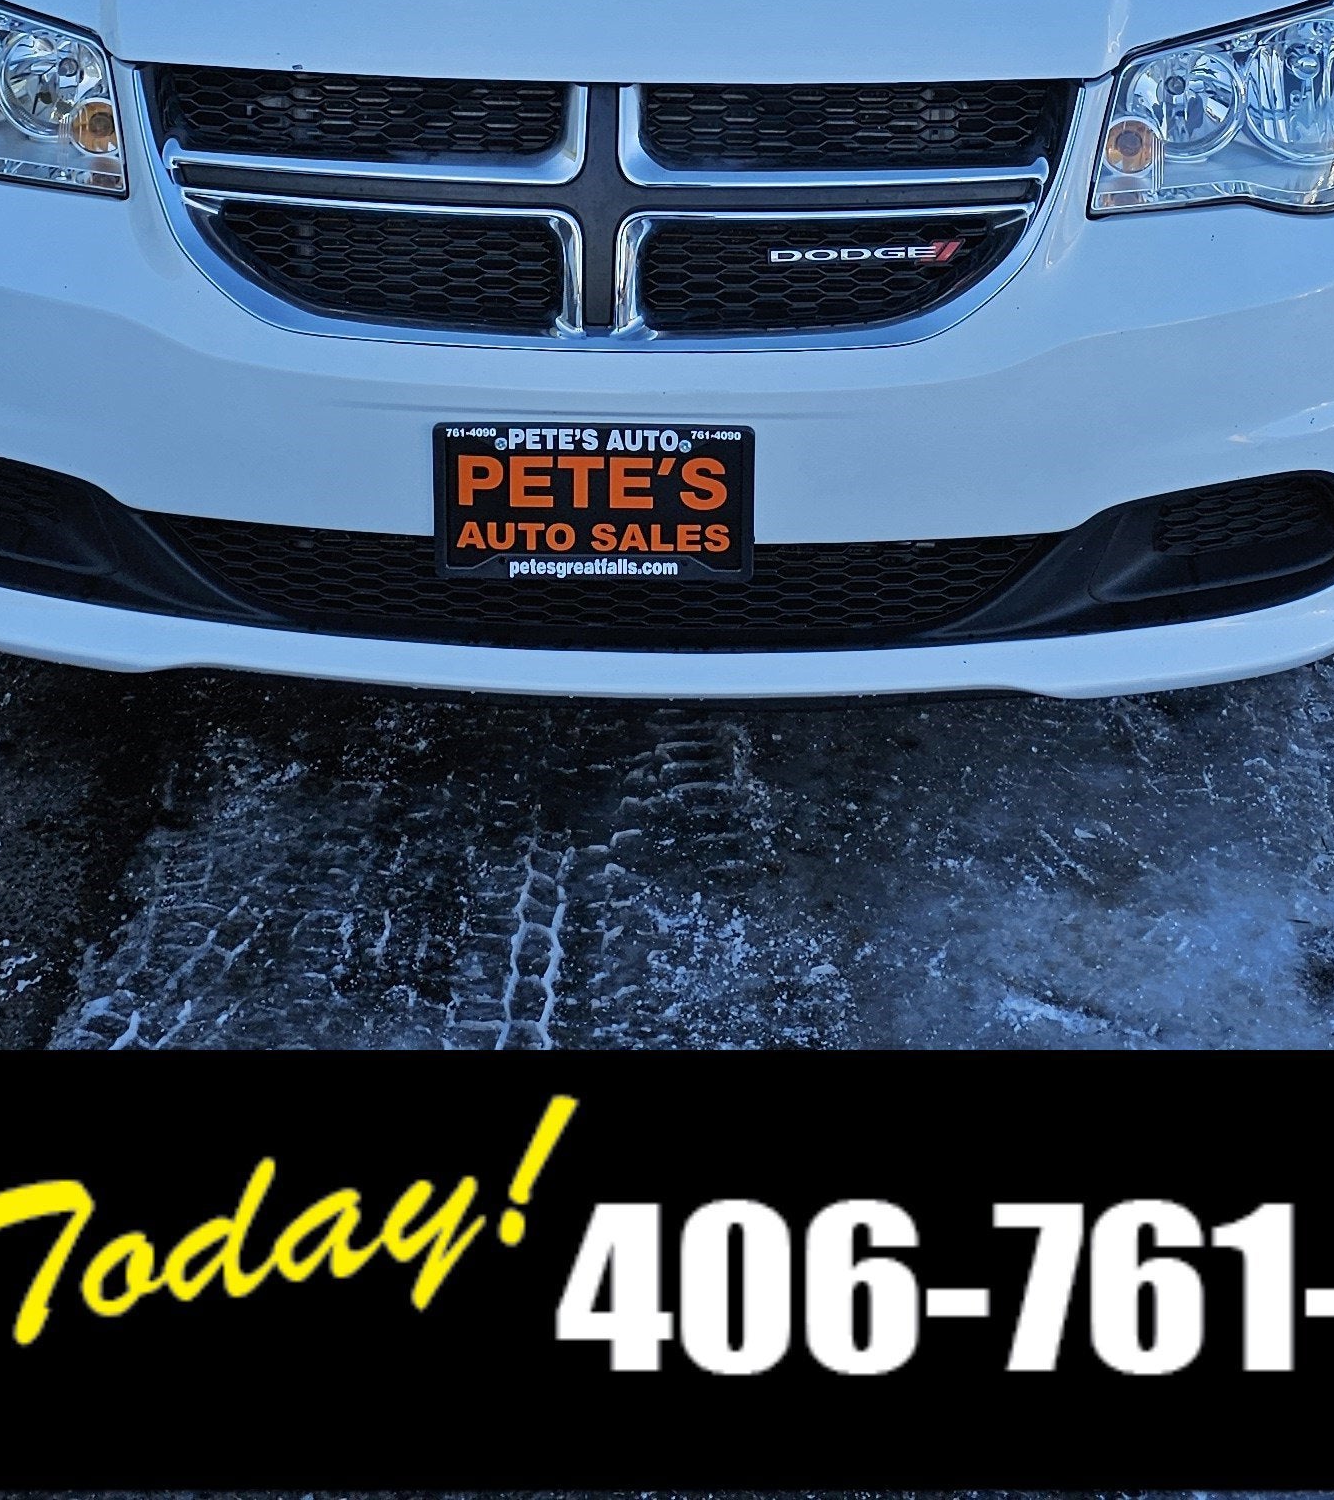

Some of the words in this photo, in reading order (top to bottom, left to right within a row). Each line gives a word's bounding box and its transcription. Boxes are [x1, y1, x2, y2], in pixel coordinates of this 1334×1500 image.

[770, 245, 937, 263] DODGE
[445, 427, 497, 439] 761-4090
[508, 428, 599, 451] PETE'S
[605, 429, 679, 452] AUTO
[690, 430, 742, 441] 761-4090
[457, 455, 728, 511] PETE'S
[456, 521, 576, 551] AUTO
[590, 523, 731, 552] SALES
[509, 557, 679, 579] petesgreatfalls.com
